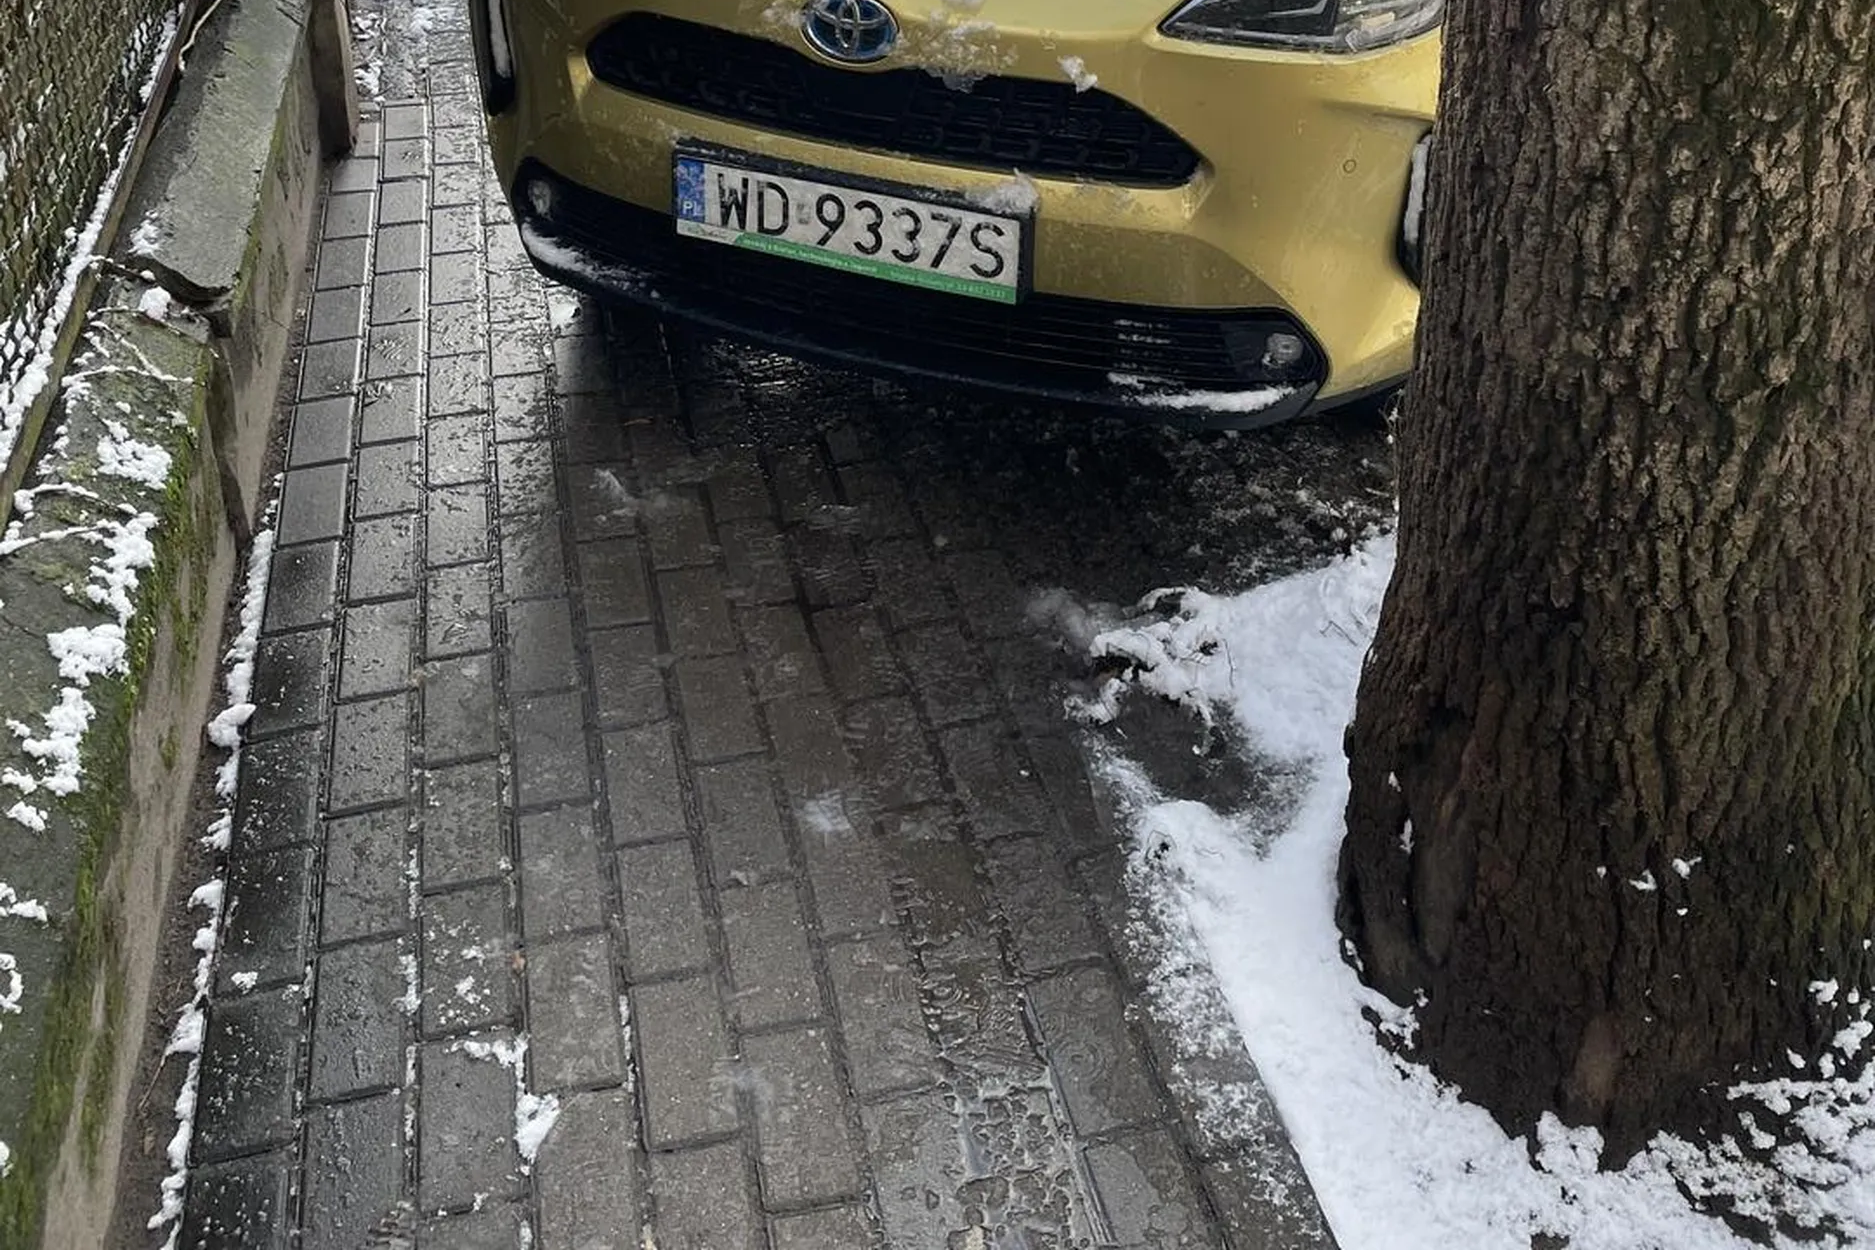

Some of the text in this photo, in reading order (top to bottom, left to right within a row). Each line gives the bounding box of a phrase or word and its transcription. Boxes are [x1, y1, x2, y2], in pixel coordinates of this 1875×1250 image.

[682, 200, 704, 217] PL
[717, 172, 789, 236] WD
[815, 193, 1006, 279] 9337S
